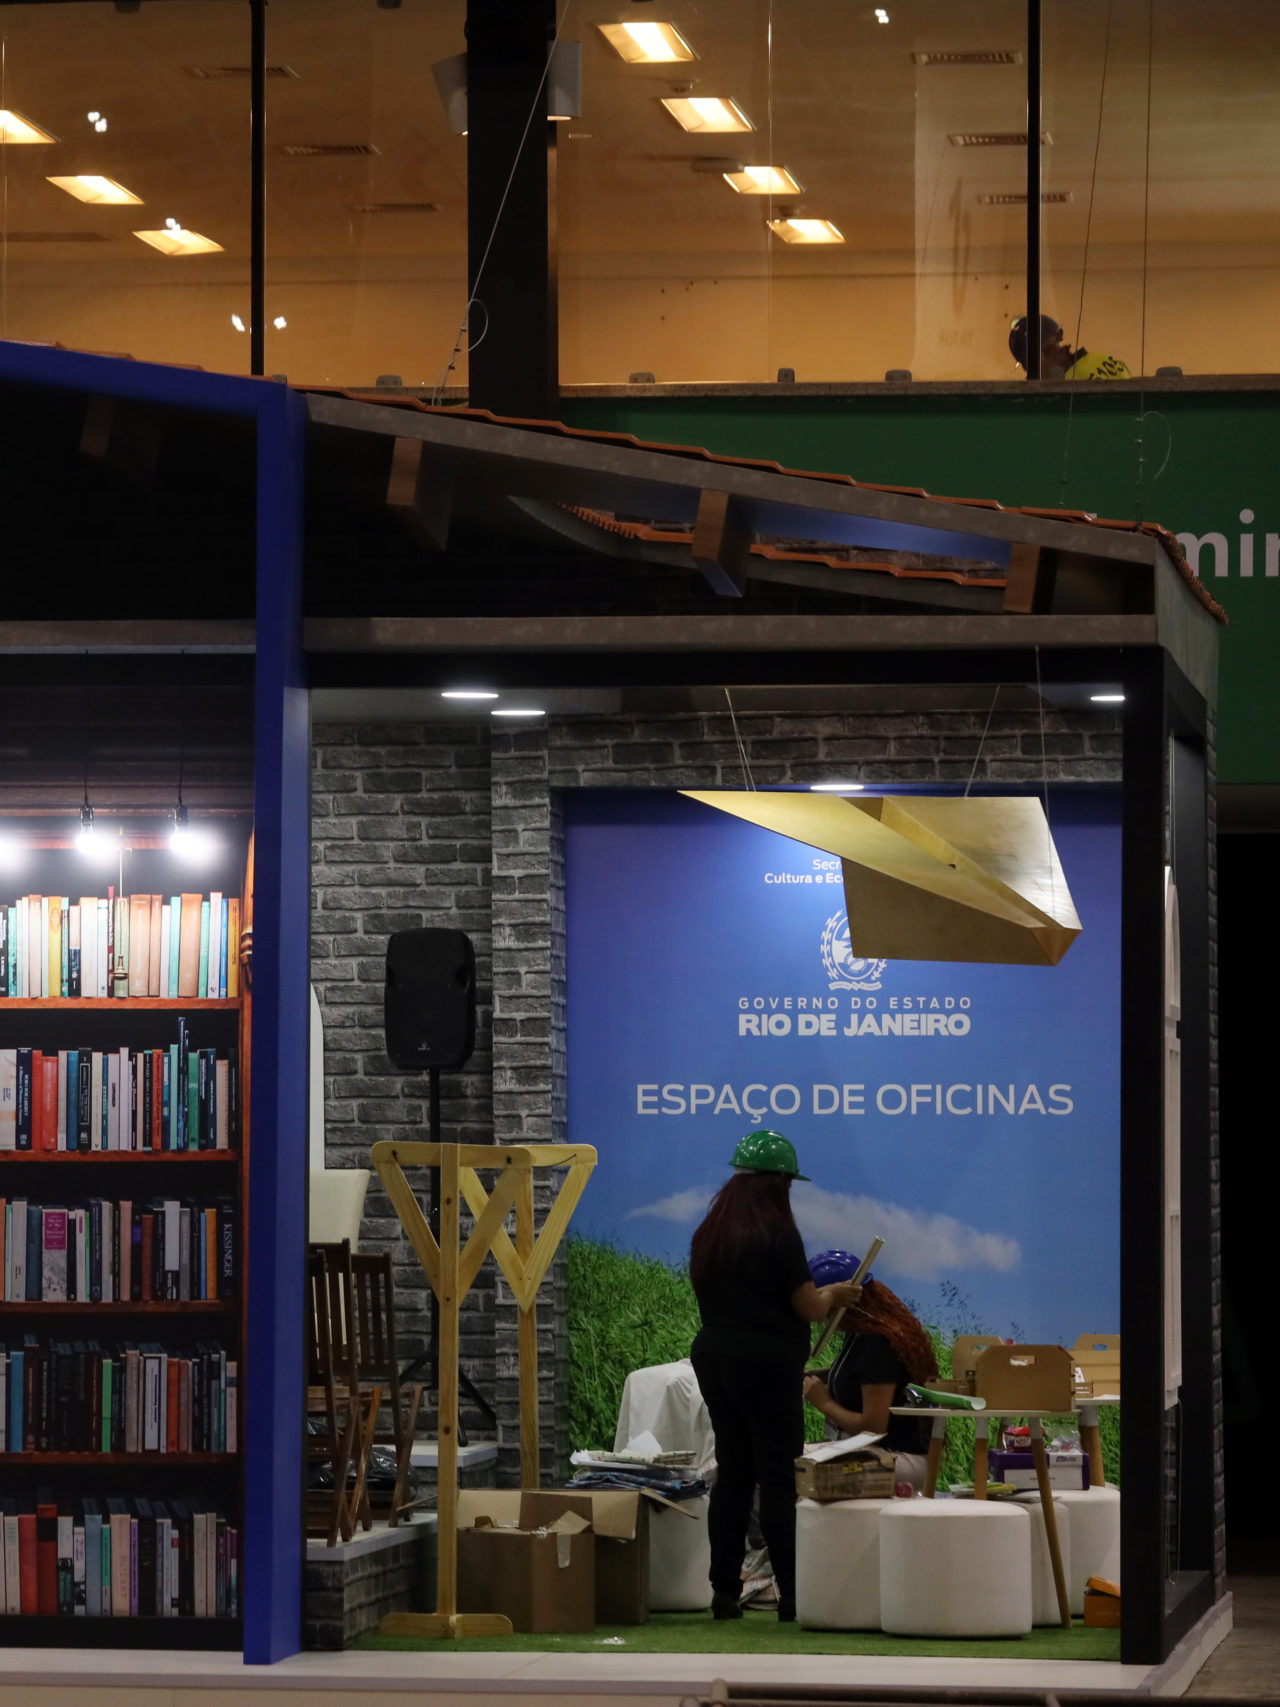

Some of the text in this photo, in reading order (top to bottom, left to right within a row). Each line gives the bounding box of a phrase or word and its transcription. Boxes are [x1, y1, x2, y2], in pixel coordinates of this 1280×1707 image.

[764, 872, 813, 884] Cultura
[815, 874, 823, 884] e
[738, 997, 972, 1009] GOVERNO DO ESTADO
[738, 1013, 971, 1037] RIO DE JANEIRO
[637, 1084, 1074, 1123] ESPAÇO DE OFICINAS
[223, 1223, 234, 1277] KISSINGER
